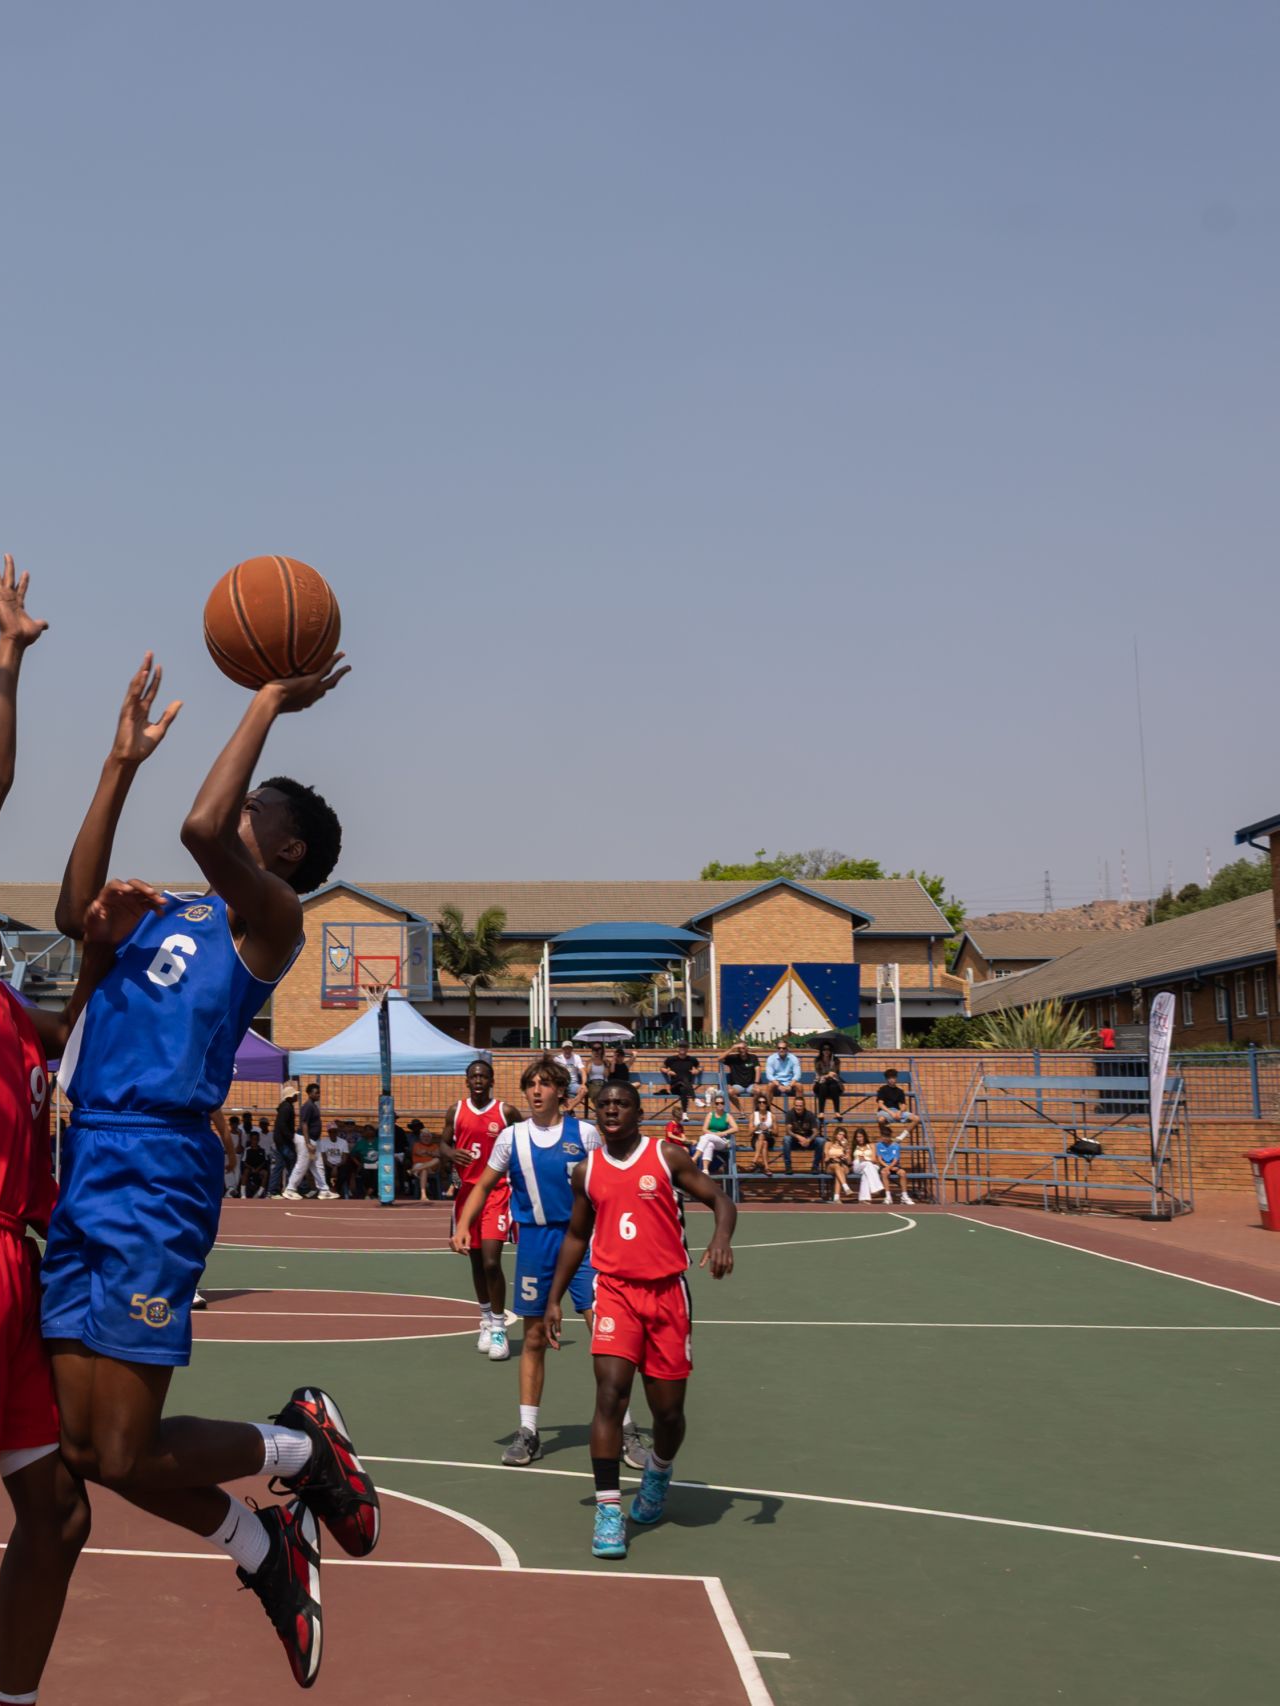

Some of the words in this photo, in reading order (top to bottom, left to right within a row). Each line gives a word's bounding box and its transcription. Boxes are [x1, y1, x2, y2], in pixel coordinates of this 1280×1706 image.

[146, 933, 197, 987] 6
[411, 947, 423, 966] 5
[30, 1065, 47, 1120] 9
[471, 1142, 481, 1159] 5
[497, 1214, 507, 1231] 5
[618, 1212, 637, 1240] 6
[521, 1276, 538, 1301] 5
[128, 1293, 171, 1329] 50
